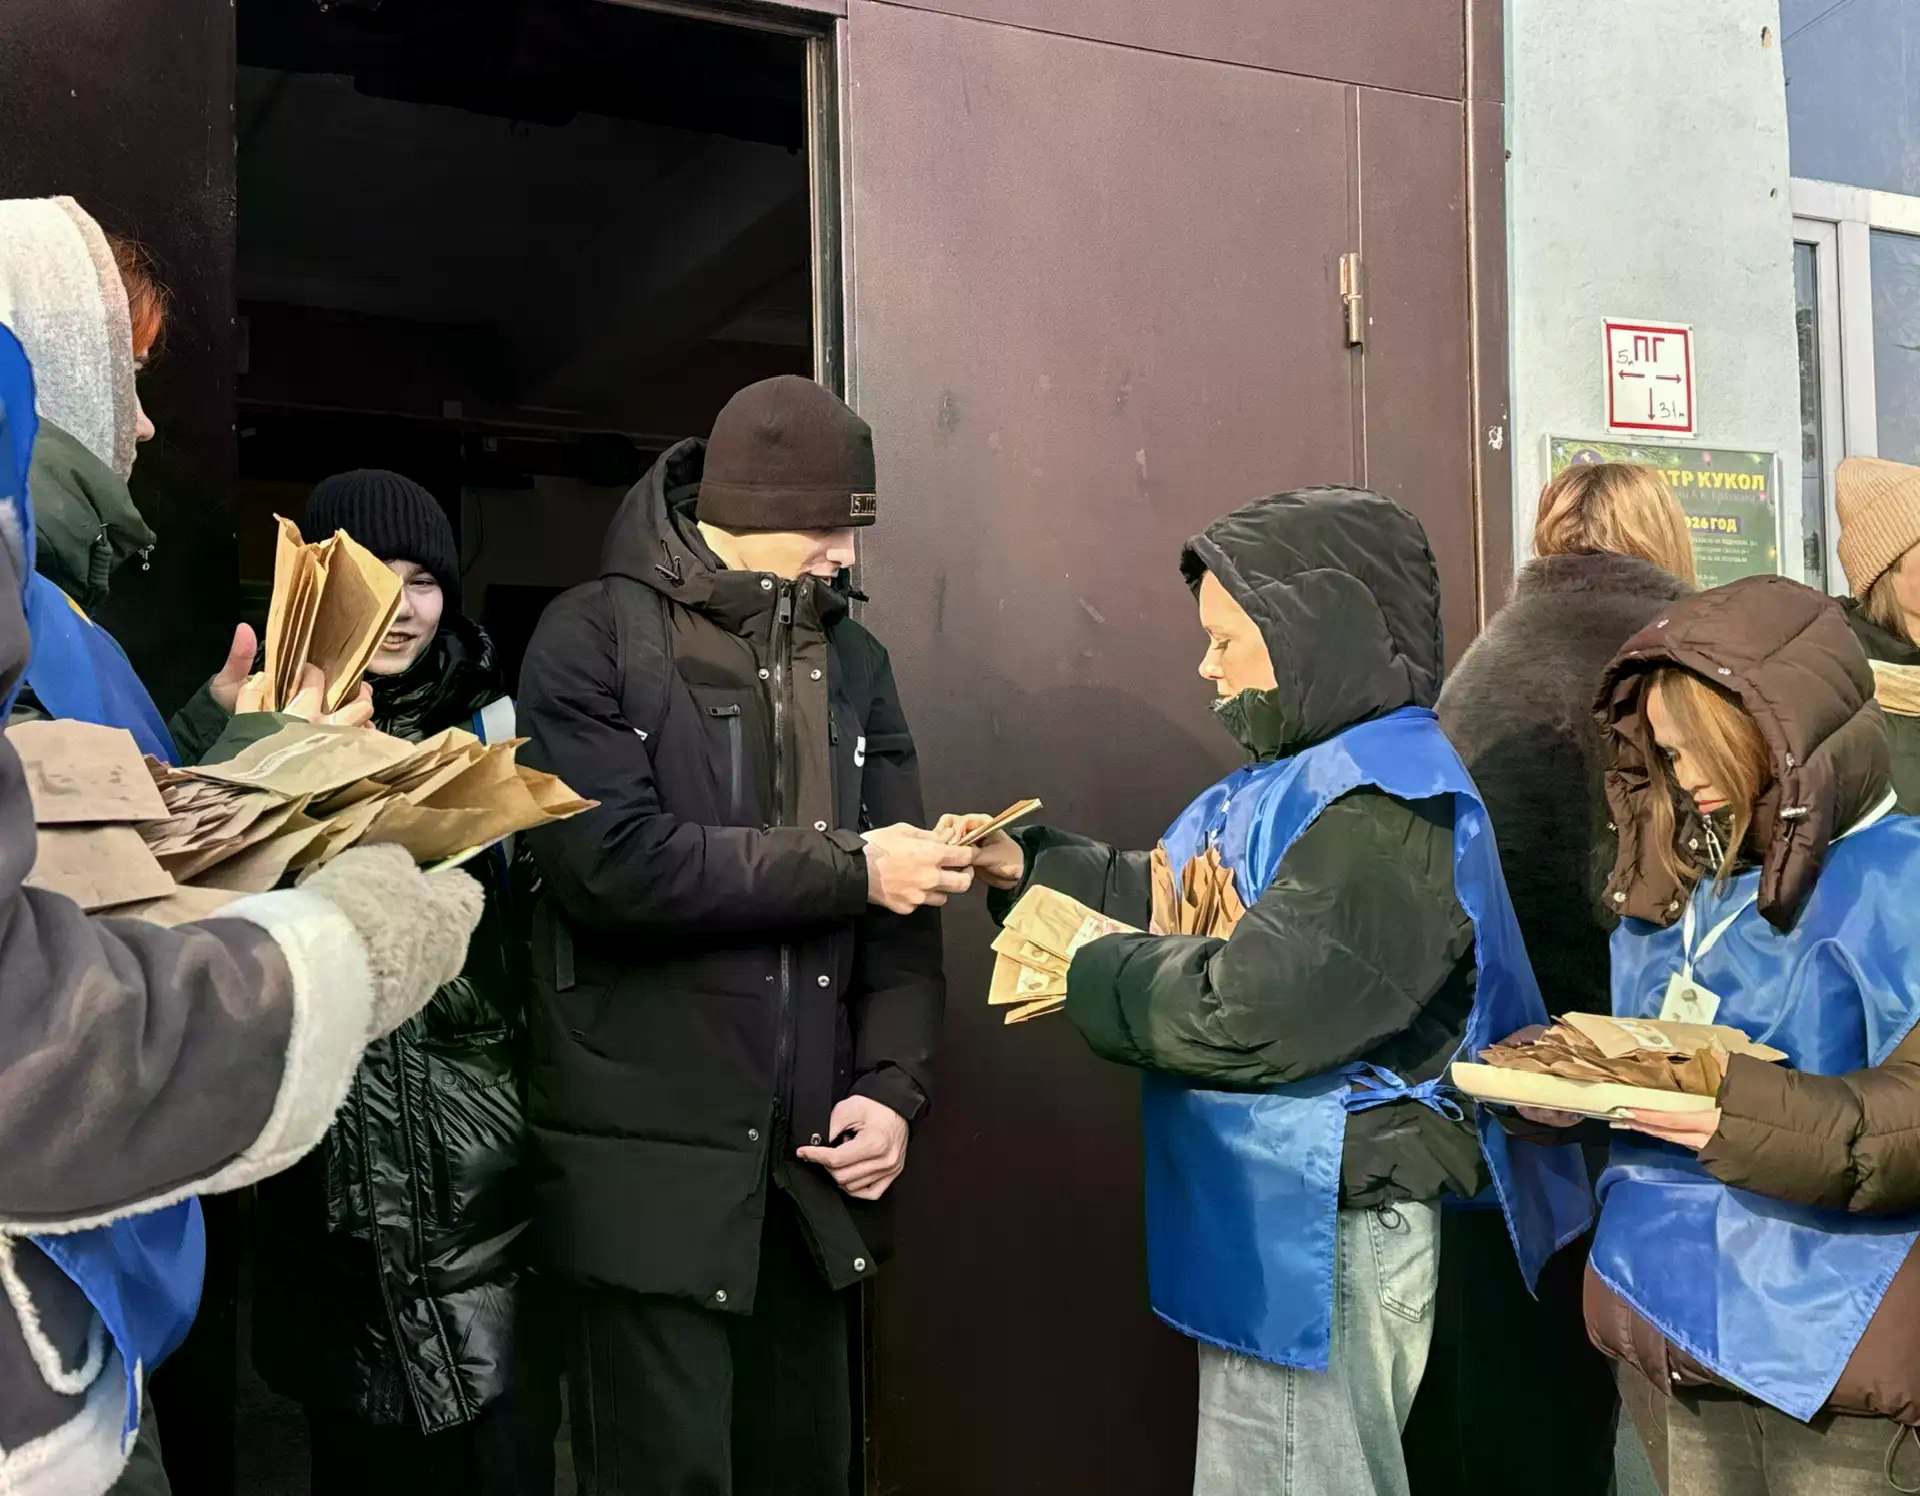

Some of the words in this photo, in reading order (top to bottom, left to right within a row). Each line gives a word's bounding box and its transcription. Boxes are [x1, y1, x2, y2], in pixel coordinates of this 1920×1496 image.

[1633, 335, 1665, 363] ПГ
[1696, 471, 1765, 491] КУКОЛ
[1684, 515, 1709, 530] 026
[1709, 516, 1738, 533] ГОД
